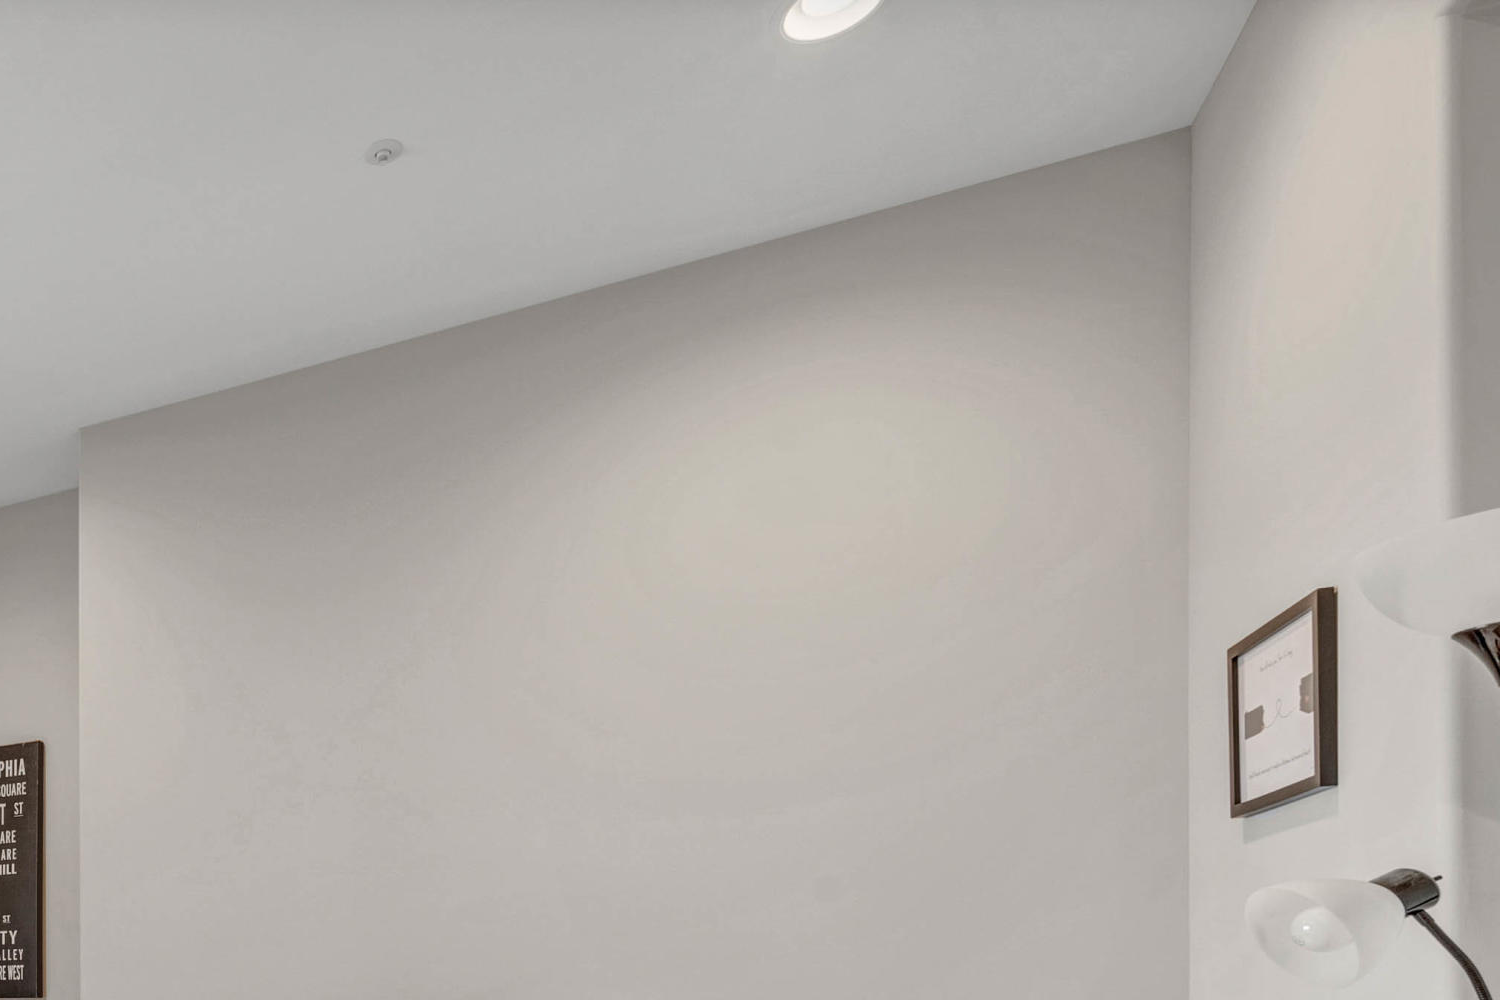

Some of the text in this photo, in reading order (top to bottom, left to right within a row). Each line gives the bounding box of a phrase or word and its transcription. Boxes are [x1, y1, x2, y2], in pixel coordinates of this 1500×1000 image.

[13, 802, 24, 816] ST
[2, 915, 11, 923] ST
[7, 965, 24, 980] WEST
